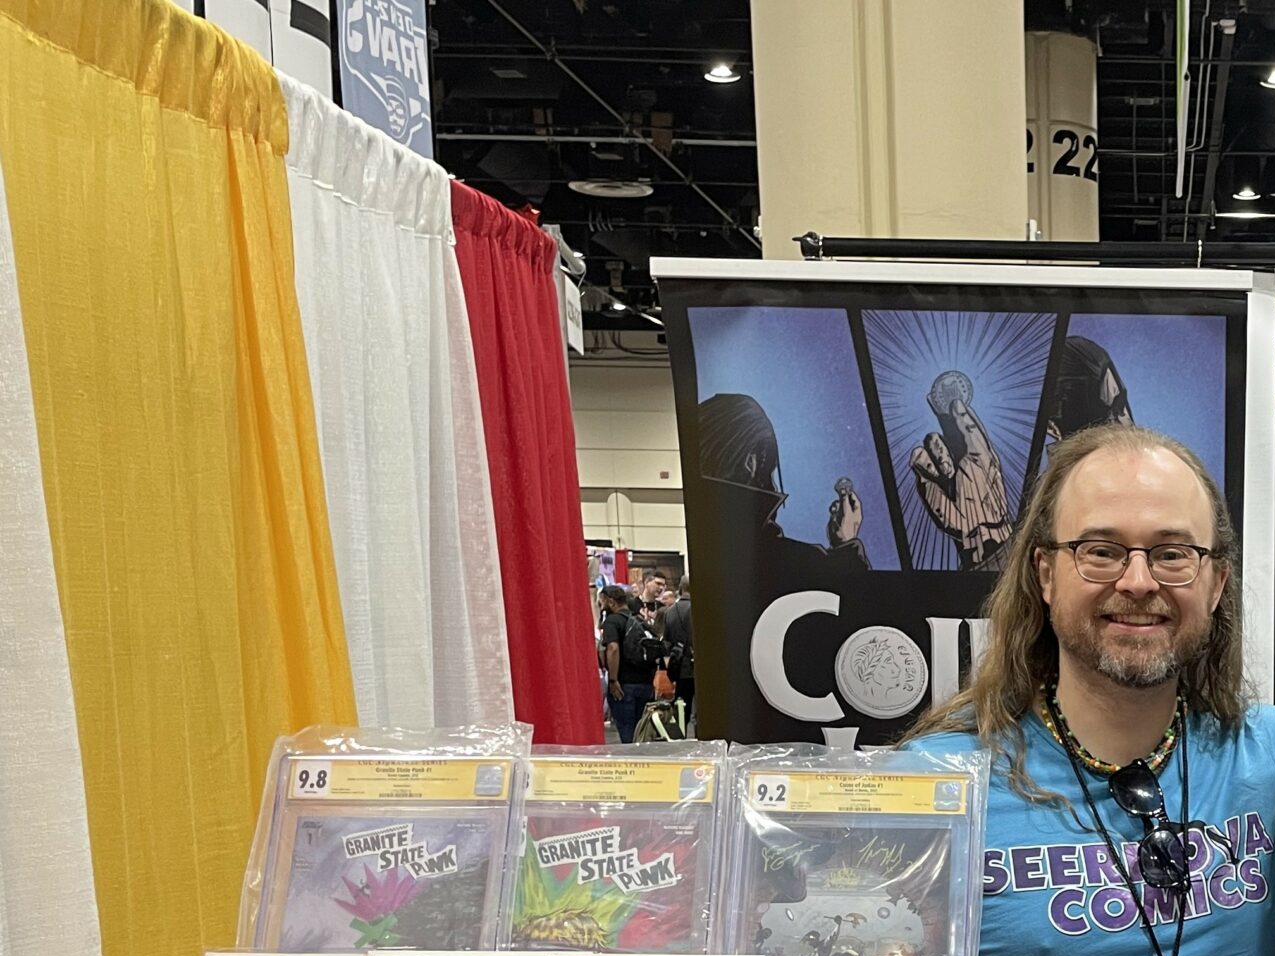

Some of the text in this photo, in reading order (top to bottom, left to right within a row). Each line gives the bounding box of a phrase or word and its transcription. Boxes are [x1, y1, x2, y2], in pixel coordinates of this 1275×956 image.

[299, 769, 328, 789] 9.8
[757, 784, 786, 802] 9.2
[345, 827, 410, 857] GRANITE
[538, 833, 615, 865] GRANITE
[379, 846, 425, 870] STATE
[408, 848, 456, 877] PUNK
[580, 848, 635, 882] STATE
[619, 858, 674, 891] PUNK
[1048, 857, 1269, 936] COMICS
